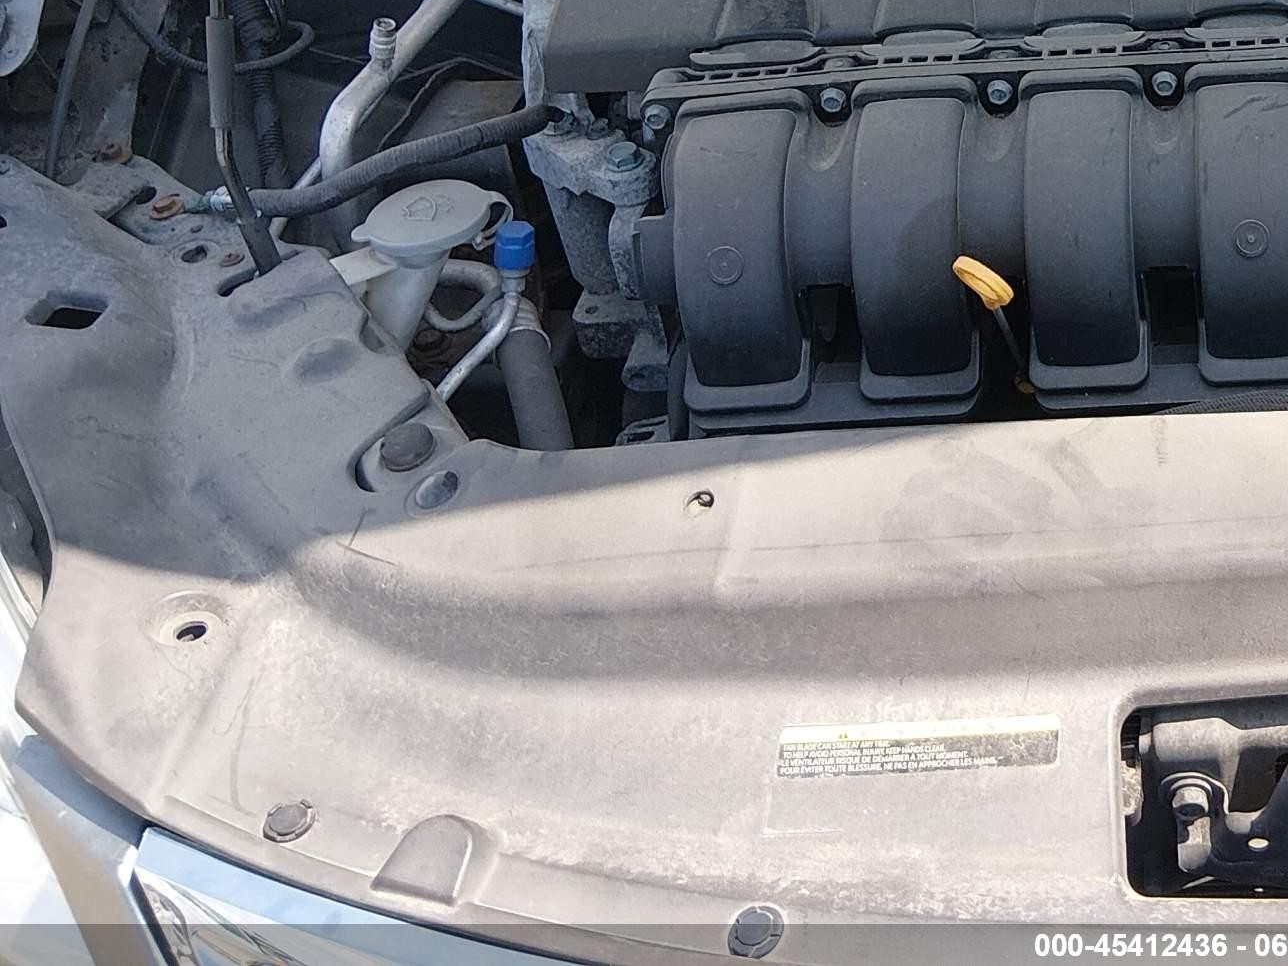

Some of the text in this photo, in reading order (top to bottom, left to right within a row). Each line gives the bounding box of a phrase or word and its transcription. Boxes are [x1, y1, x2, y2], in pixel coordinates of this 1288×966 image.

[809, 750, 829, 758] AVOID
[830, 749, 861, 757] PERSONAL
[886, 746, 902, 754] KEEP
[902, 745, 924, 753] HANDS
[791, 757, 834, 765] VENTILATEUR
[836, 756, 861, 764] RISQUE
[862, 755, 871, 763] DE
[917, 752, 935, 760] TOUT
[825, 764, 847, 773] TOUTE
[908, 761, 918, 769] EN
[919, 759, 960, 767] APPROCHER
